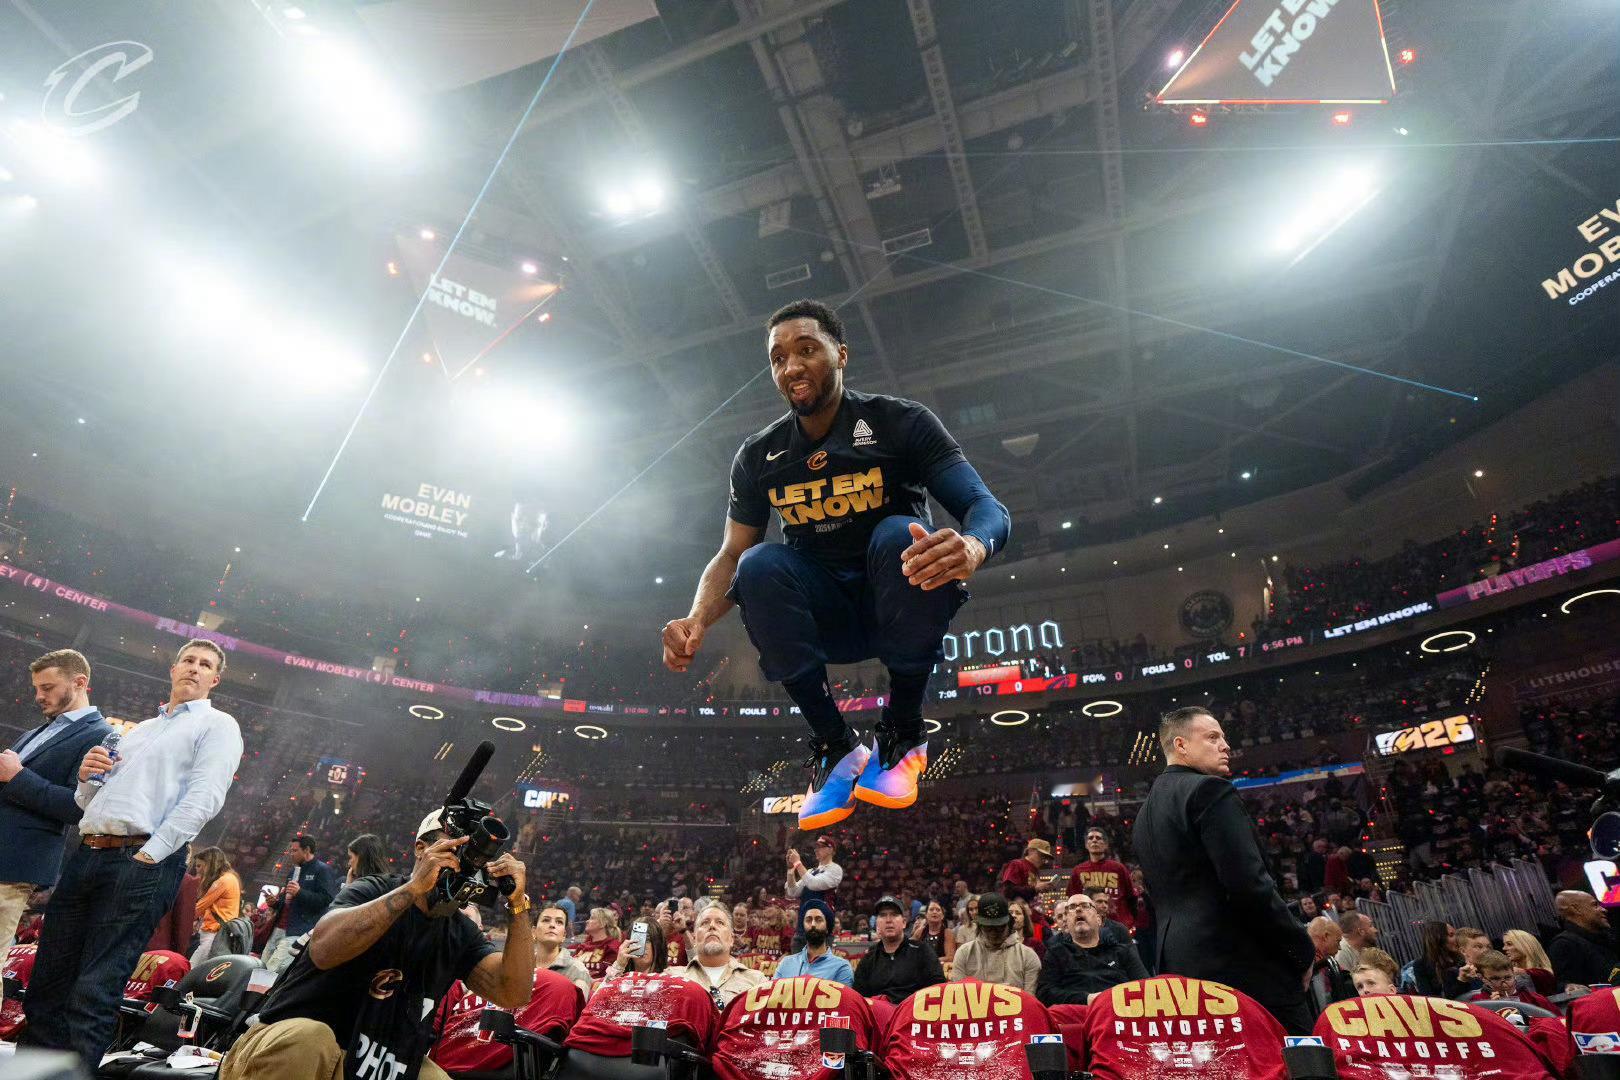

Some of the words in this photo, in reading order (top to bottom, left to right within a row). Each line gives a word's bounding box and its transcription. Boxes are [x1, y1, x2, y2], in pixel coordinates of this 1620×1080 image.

[1238, 8, 1285, 71] LET
[418, 483, 471, 508] EVAN
[768, 478, 827, 507] LET
[832, 467, 884, 496] EM
[381, 493, 468, 526] MOBLEY
[1467, 549, 1592, 600] PLAYOFFS
[55, 586, 108, 612] CENTER
[1324, 624, 1353, 638] LET
[1354, 618, 1378, 631] EM
[1378, 602, 1433, 624] KNOW.
[942, 620, 1063, 661] orona
[1206, 652, 1230, 663] TOL
[1238, 647, 1246, 657] 7
[284, 655, 314, 669] EVAN
[316, 662, 362, 678] MOBLEY
[391, 677, 435, 693] CENTER
[1114, 672, 1123, 681] 0
[1142, 662, 1176, 677] FOULS
[1184, 658, 1193, 668] 0
[1014, 681, 1023, 692] 0
[699, 707, 715, 715] TOL
[722, 707, 729, 716] 7
[739, 707, 767, 716] FOULS
[772, 706, 780, 716] 0
[790, 706, 801, 714] FG
[1080, 871, 1119, 888] CAVS
[745, 977, 845, 1012] CAVS
[912, 982, 1022, 1022] CAVS
[1111, 977, 1240, 1018] CAVS
[911, 1018, 1024, 1039] PLAYOFFS
[1114, 1016, 1243, 1037] PLAYOFFS
[1325, 995, 1483, 1038] CAVS
[1337, 1037, 1496, 1059] PLAYOFFS
